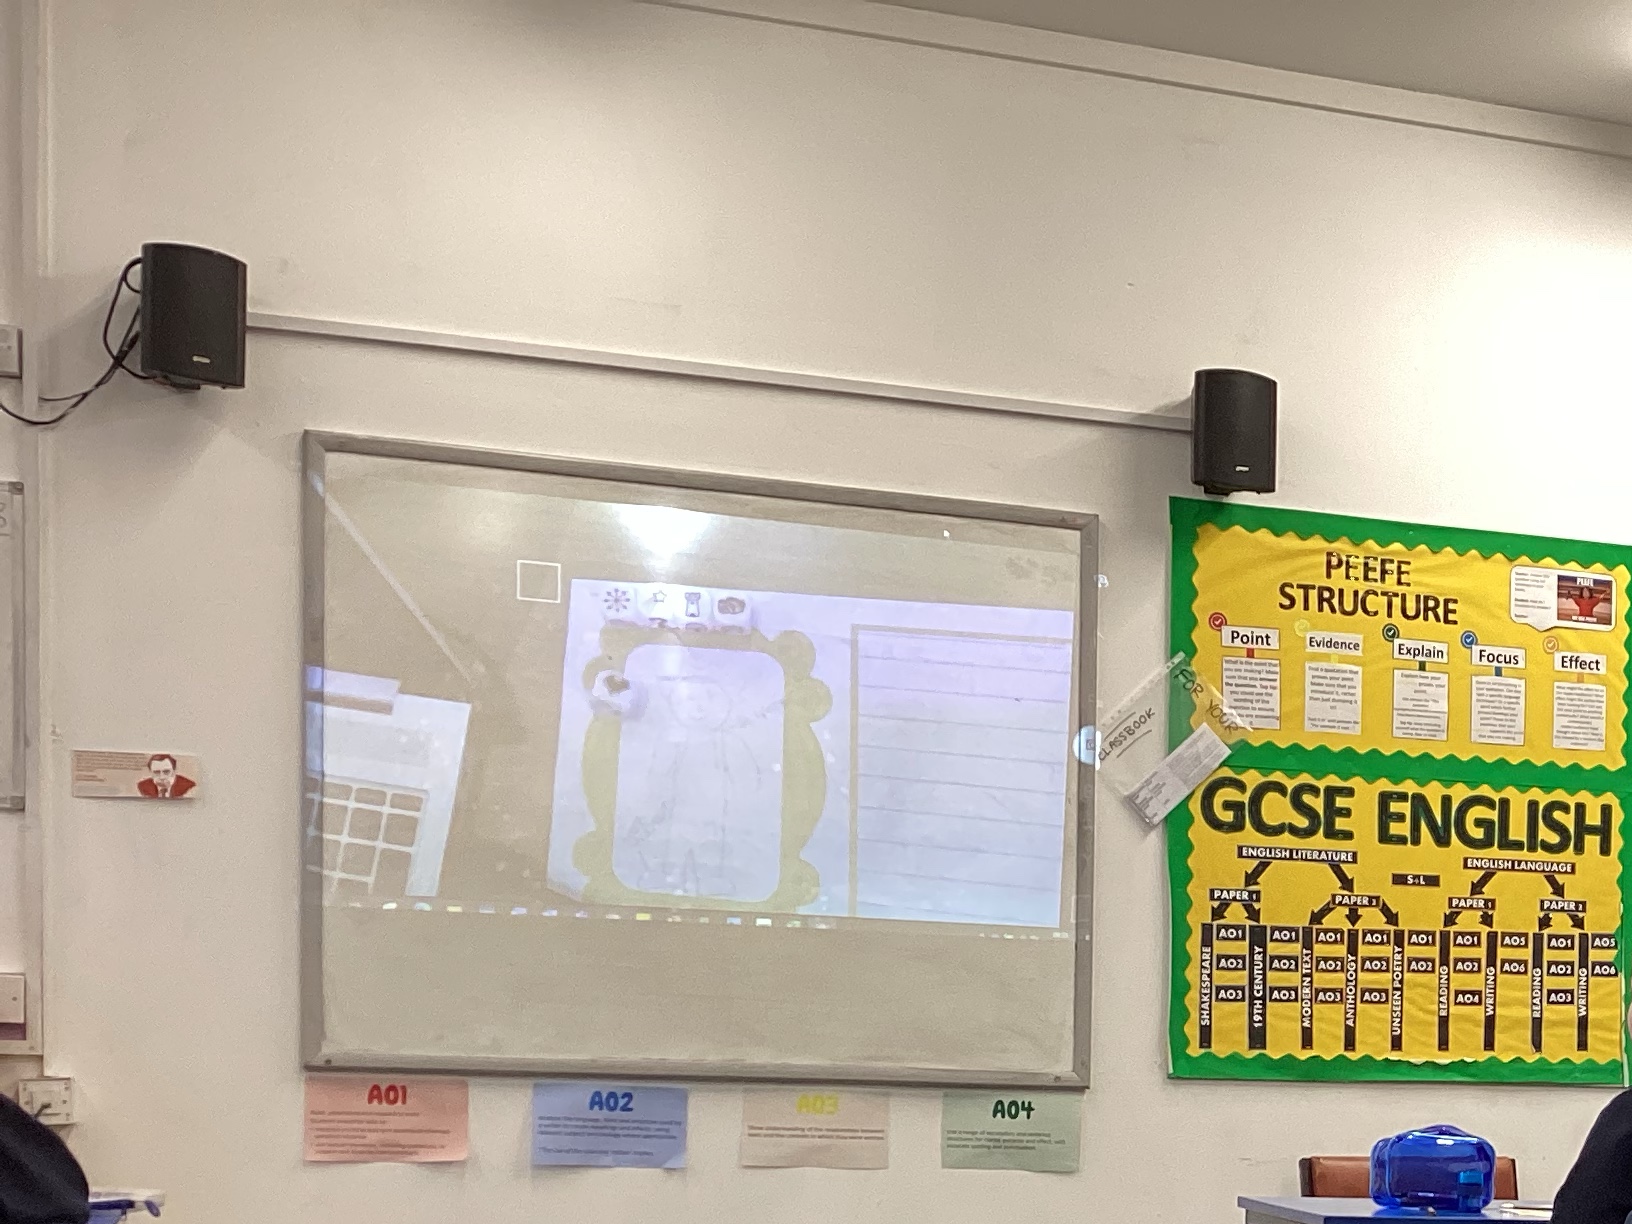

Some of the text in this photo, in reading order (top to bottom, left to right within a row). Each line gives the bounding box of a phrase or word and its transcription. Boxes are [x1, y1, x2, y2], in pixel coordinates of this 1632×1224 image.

[1326, 551, 1412, 587] PEEFE
[1278, 582, 1459, 625] STRUCTURE
[1231, 630, 1271, 646] Point
[1309, 636, 1360, 651] Evidence
[1398, 643, 1444, 659] Explain
[1479, 650, 1519, 665] Focus
[1561, 656, 1601, 672] Effect
[1173, 668, 1204, 698] FOR
[1205, 699, 1239, 735] YOUR
[1098, 707, 1156, 762] CLASSBOOK
[1200, 776, 1355, 841] GCSE
[1377, 791, 1612, 856] ENGLISH
[1242, 847, 1353, 862] ENGLISH LITERATURE
[1467, 859, 1572, 872] ENGLISH LANGUAGE
[1214, 890, 1249, 900] PAPER
[1335, 895, 1369, 905] PAPER
[1452, 898, 1485, 908] PAPER
[1544, 901, 1576, 910] PAPER
[1219, 928, 1242, 938] AO1
[1273, 930, 1296, 940] AO1
[1318, 932, 1340, 942] AO1
[1364, 934, 1387, 943] AO1
[1410, 934, 1433, 943] AO1
[1456, 936, 1478, 945] AO1
[1503, 936, 1525, 945] AO5
[1550, 938, 1572, 947] AO1
[1593, 937, 1616, 947] AO5
[1219, 958, 1243, 968] AO2
[1272, 959, 1296, 970] AO2
[1318, 960, 1341, 970] AO2
[1364, 960, 1387, 970] AO2
[1410, 961, 1433, 971] AO2
[1456, 962, 1478, 971] AO2
[1503, 963, 1525, 972] AO6
[1549, 965, 1572, 974] AO2
[1593, 965, 1616, 975] AO6
[1200, 946, 1211, 1026] SHAKESPEARE
[1253, 946, 1264, 1028] 19TH CENTURY
[1302, 948, 1311, 1028] MODERN TEXT
[1346, 954, 1356, 1027] ANTHOLOGY
[1392, 945, 1402, 1035] UNSEEN POETRY
[1439, 965, 1448, 1016] READING
[1486, 966, 1495, 1016] WRITING
[1218, 990, 1243, 1000] AO3
[1272, 990, 1296, 1000] AO3
[1317, 992, 1341, 1001] AO3
[1363, 992, 1386, 1001] AO3
[1532, 968, 1541, 1018] READING
[1549, 993, 1571, 1002] AO3
[1578, 968, 1587, 1017] WRITING
[1456, 994, 1479, 1003] AO4
